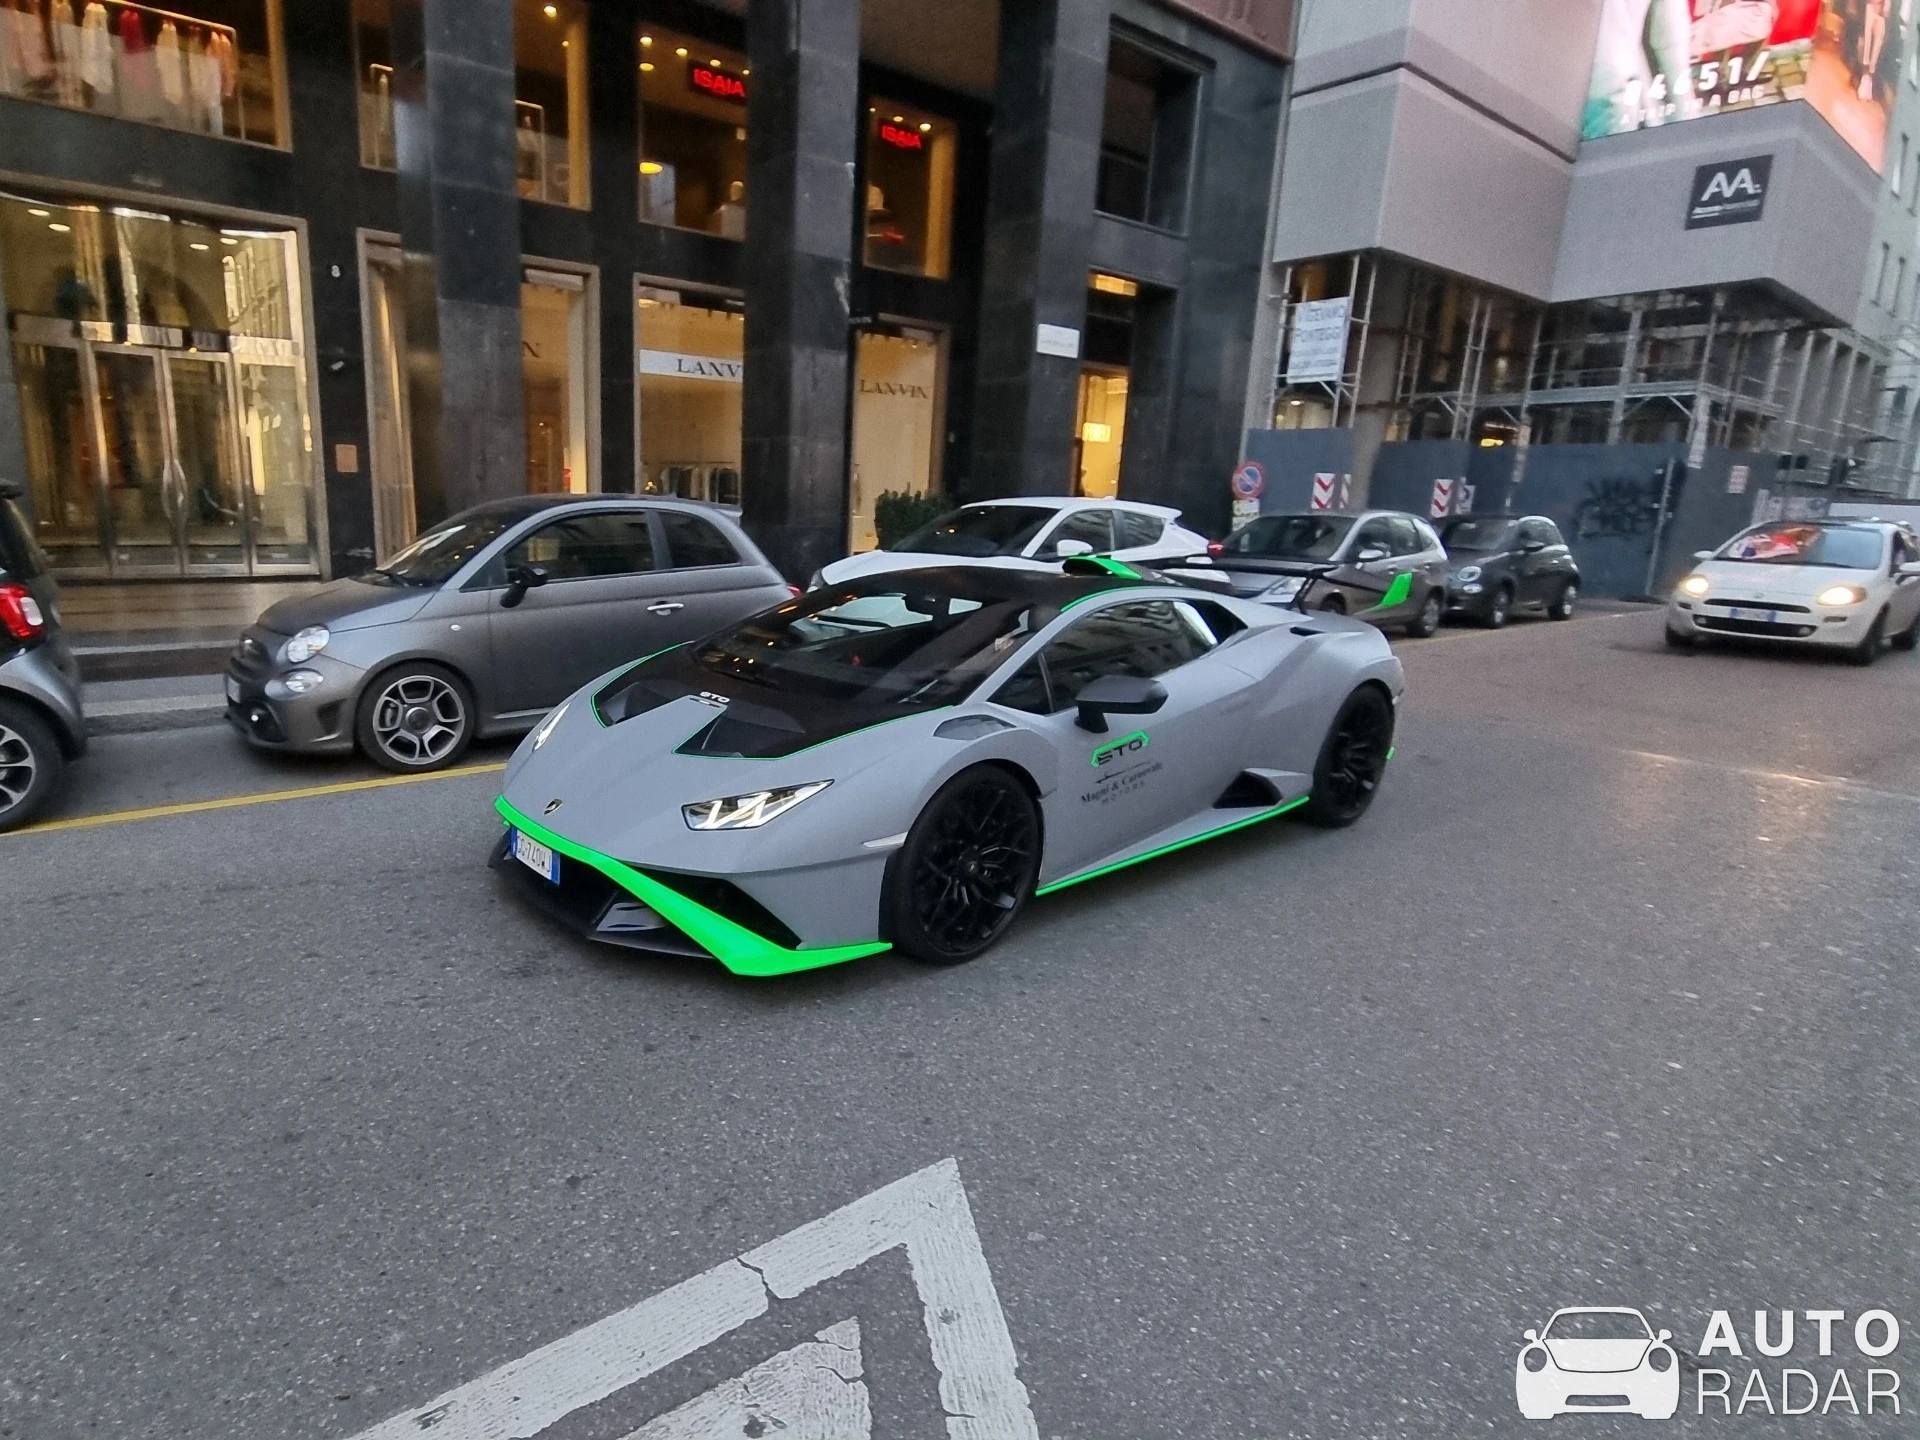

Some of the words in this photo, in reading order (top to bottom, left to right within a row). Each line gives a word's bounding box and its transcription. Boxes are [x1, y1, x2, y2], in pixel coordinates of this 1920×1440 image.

[693, 68, 746, 98] ISAIA
[881, 125, 922, 149] ISAIA
[860, 379, 928, 399] LANVIN
[1096, 738, 1143, 766] STO
